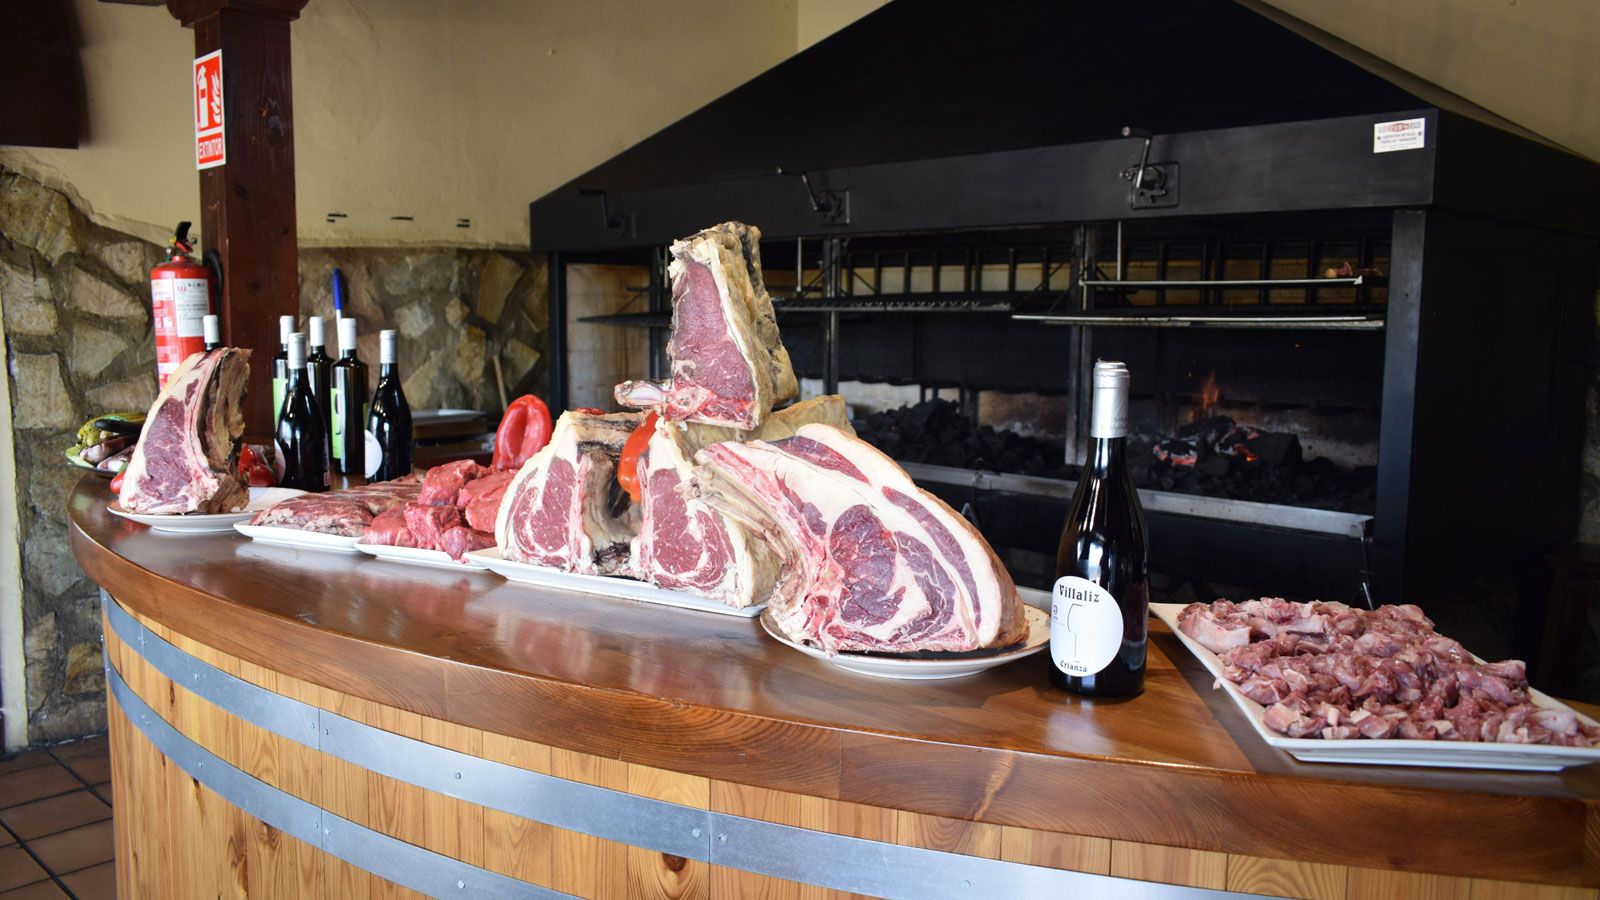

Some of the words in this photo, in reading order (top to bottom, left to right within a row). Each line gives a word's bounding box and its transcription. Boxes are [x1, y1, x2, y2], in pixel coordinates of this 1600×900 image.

[198, 138, 223, 159] EXTINTOR
[1059, 584, 1100, 603] Villaliz
[1060, 659, 1088, 673] Crianza
